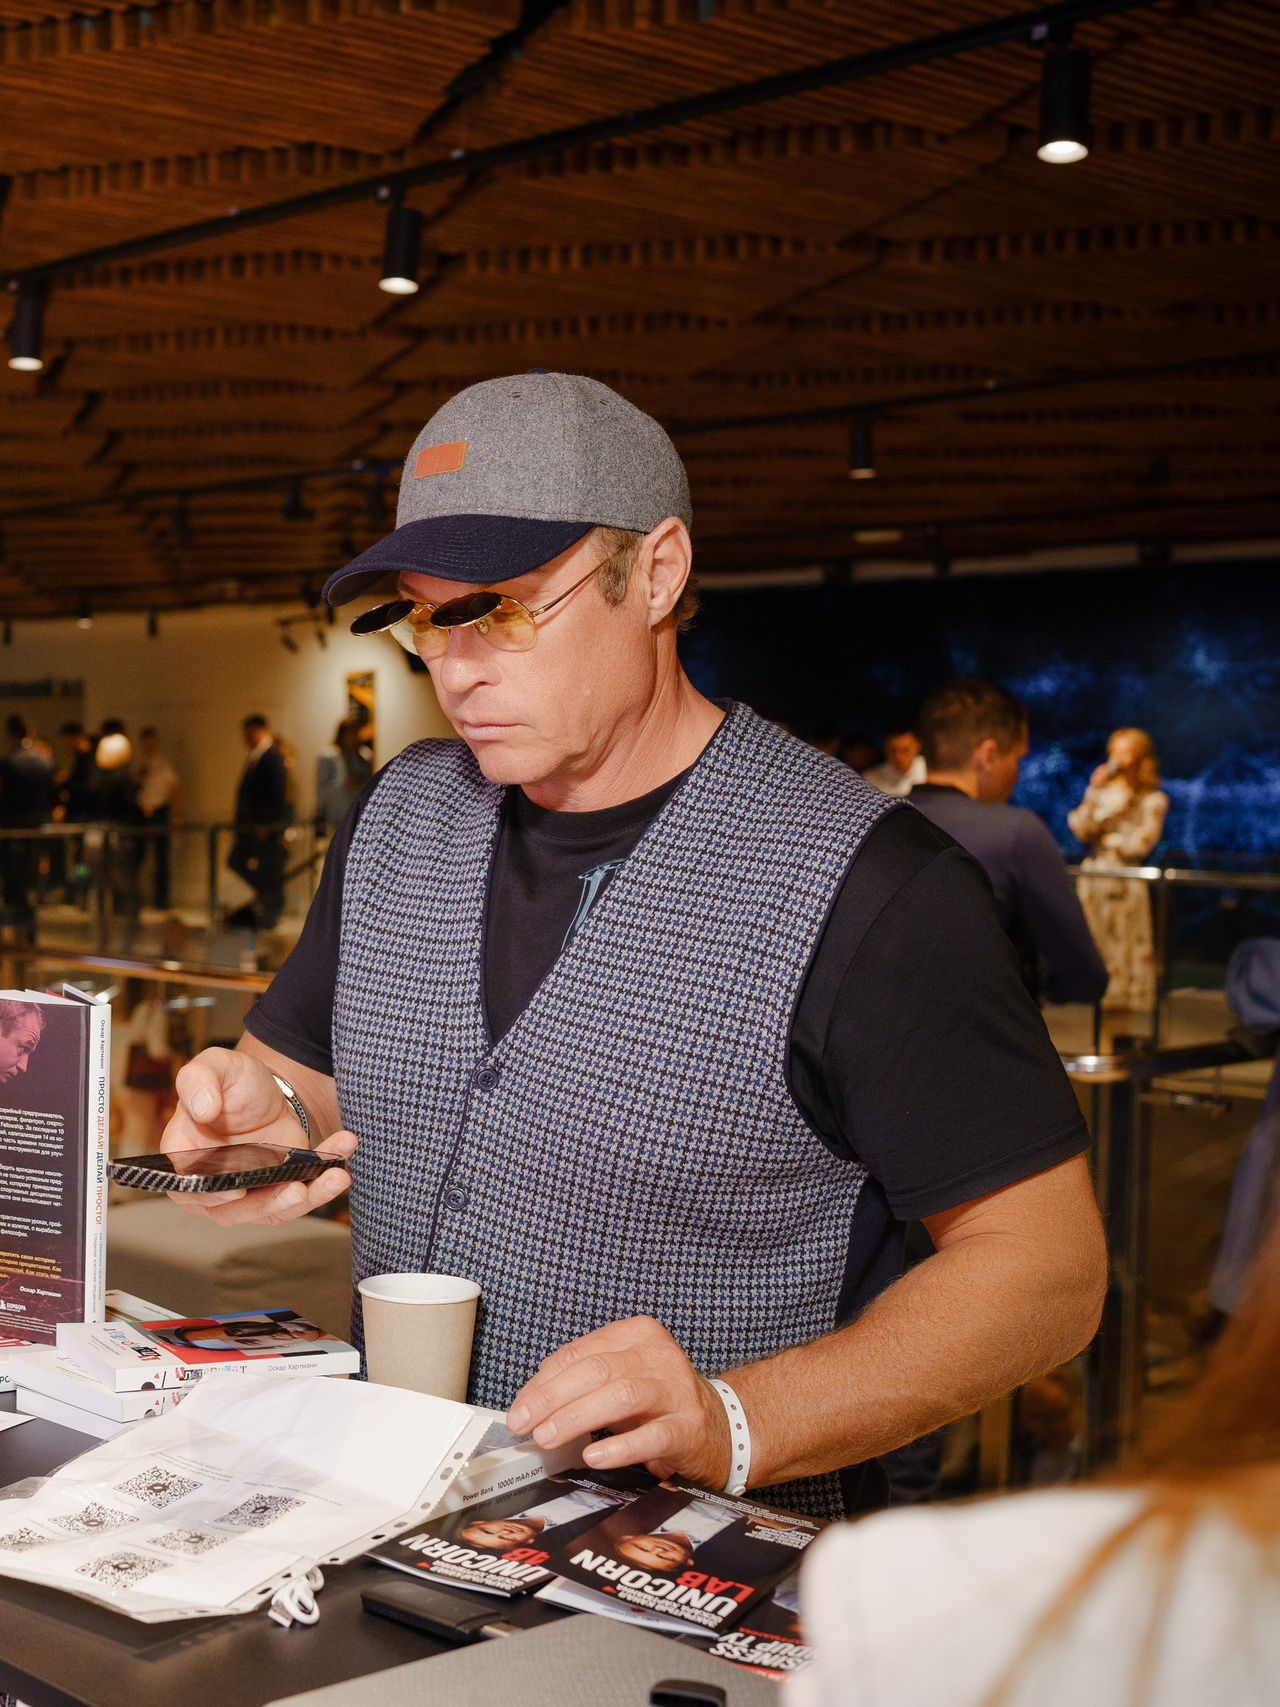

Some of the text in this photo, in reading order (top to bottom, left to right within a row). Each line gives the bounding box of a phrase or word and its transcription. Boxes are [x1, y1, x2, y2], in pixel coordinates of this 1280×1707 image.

[94, 1076, 106, 1226] ПРОСТО ДЕЛАЙ! ДЕЛАЙ ПРОСТО!
[20, 1286, 61, 1297] Оскар Хартманн
[267, 1362, 318, 1372] Оскар Хартманн
[462, 1490, 480, 1502] Power
[480, 1485, 494, 1496] Bank
[497, 1478, 514, 1490] 10000
[530, 1466, 544, 1477] SOFT
[401, 1532, 549, 1582] UNICORN
[500, 1547, 550, 1566] AB
[569, 1548, 738, 1618] UNICORN
[675, 1570, 755, 1604] LAB
